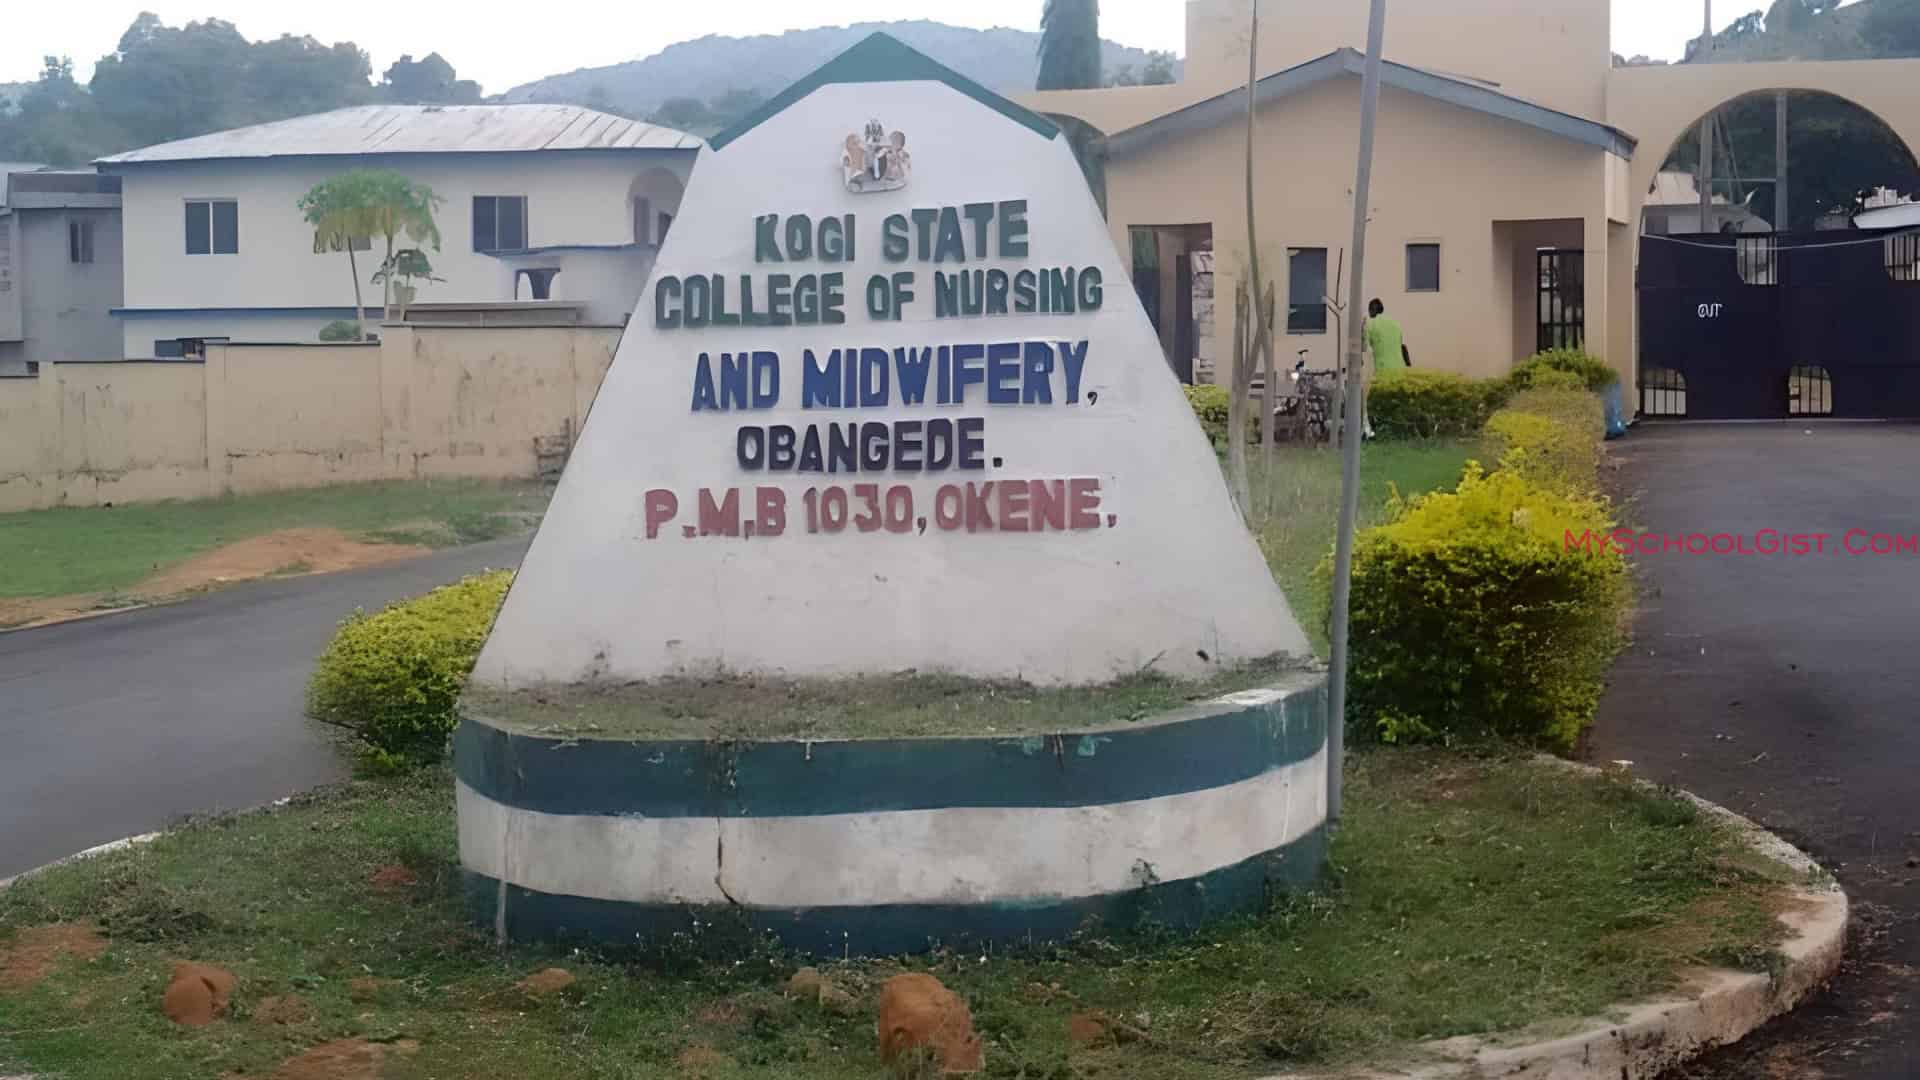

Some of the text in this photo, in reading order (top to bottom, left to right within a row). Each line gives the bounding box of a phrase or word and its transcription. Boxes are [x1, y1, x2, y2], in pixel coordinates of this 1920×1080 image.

[754, 199, 1029, 263] KOGI STATE
[655, 266, 1104, 329] COLLEGE OF NURSING
[691, 339, 1098, 411] AND MIDWIFERY,
[737, 417, 1003, 472] OBANGEDE.
